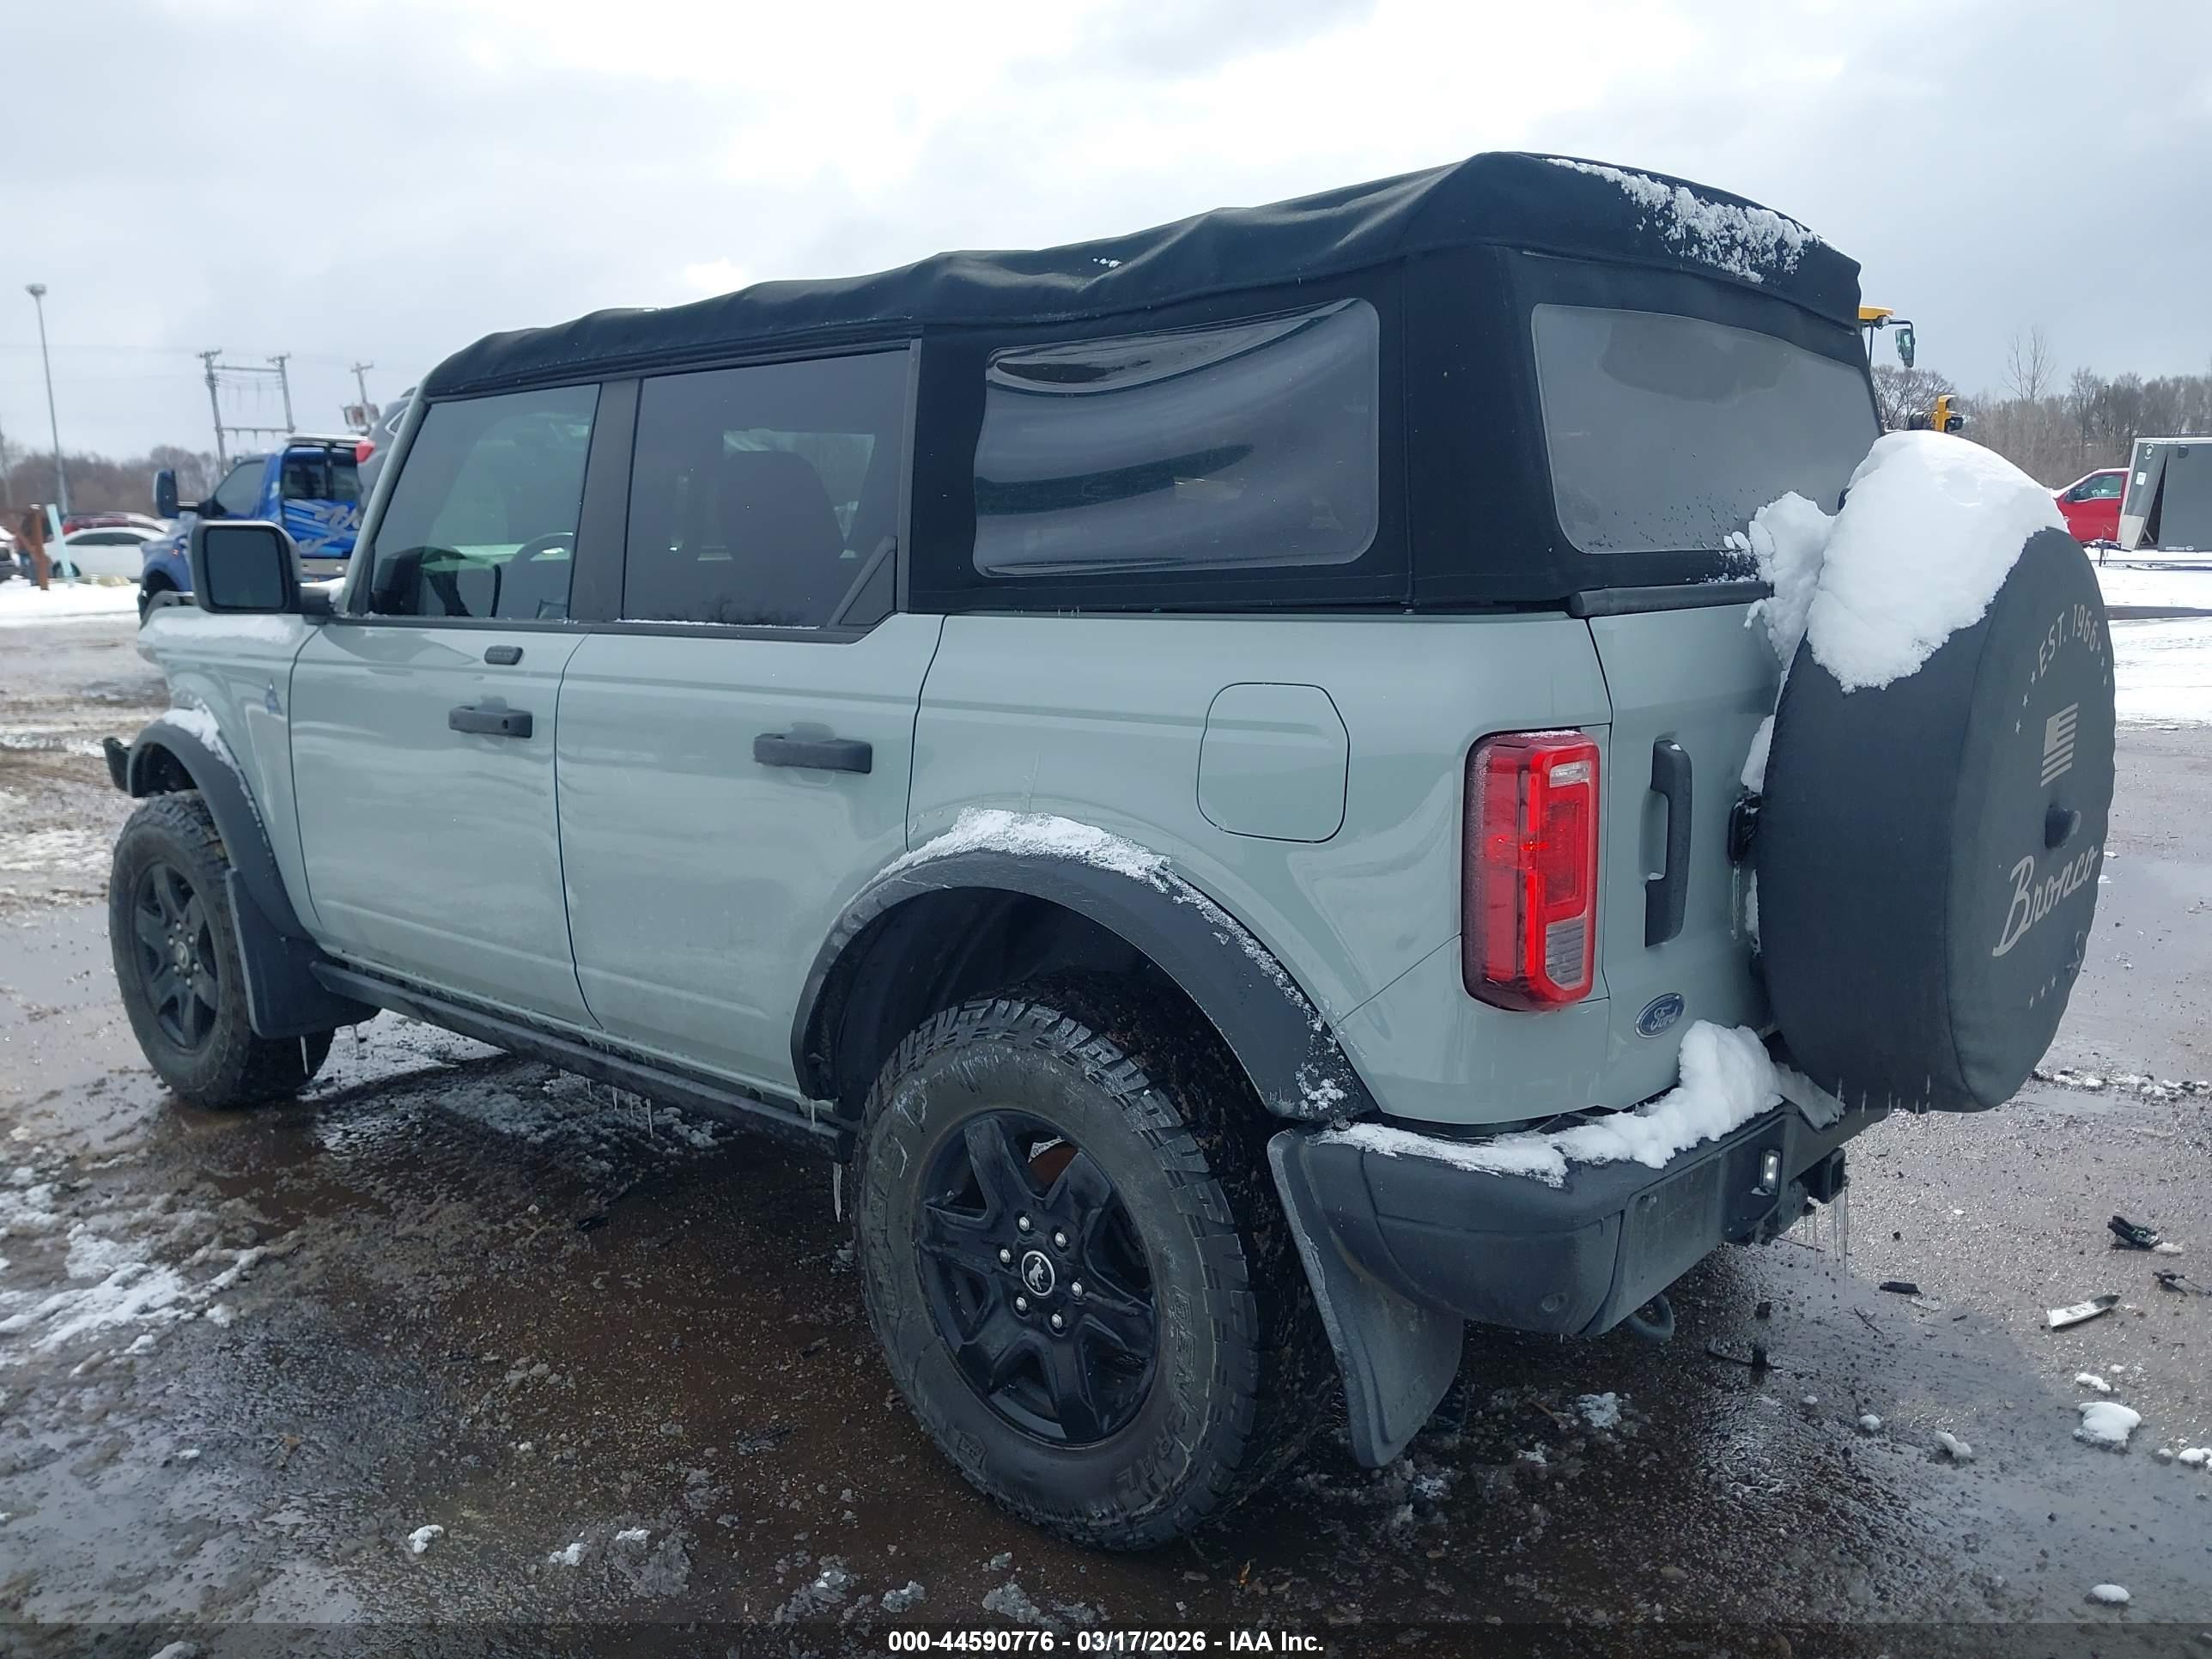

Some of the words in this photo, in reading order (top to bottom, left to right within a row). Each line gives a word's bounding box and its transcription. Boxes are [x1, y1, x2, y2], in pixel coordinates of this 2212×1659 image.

[2039, 611, 2067, 678] EST.
[2071, 604, 2099, 653] 1966
[1992, 844, 2099, 957] Bronco
